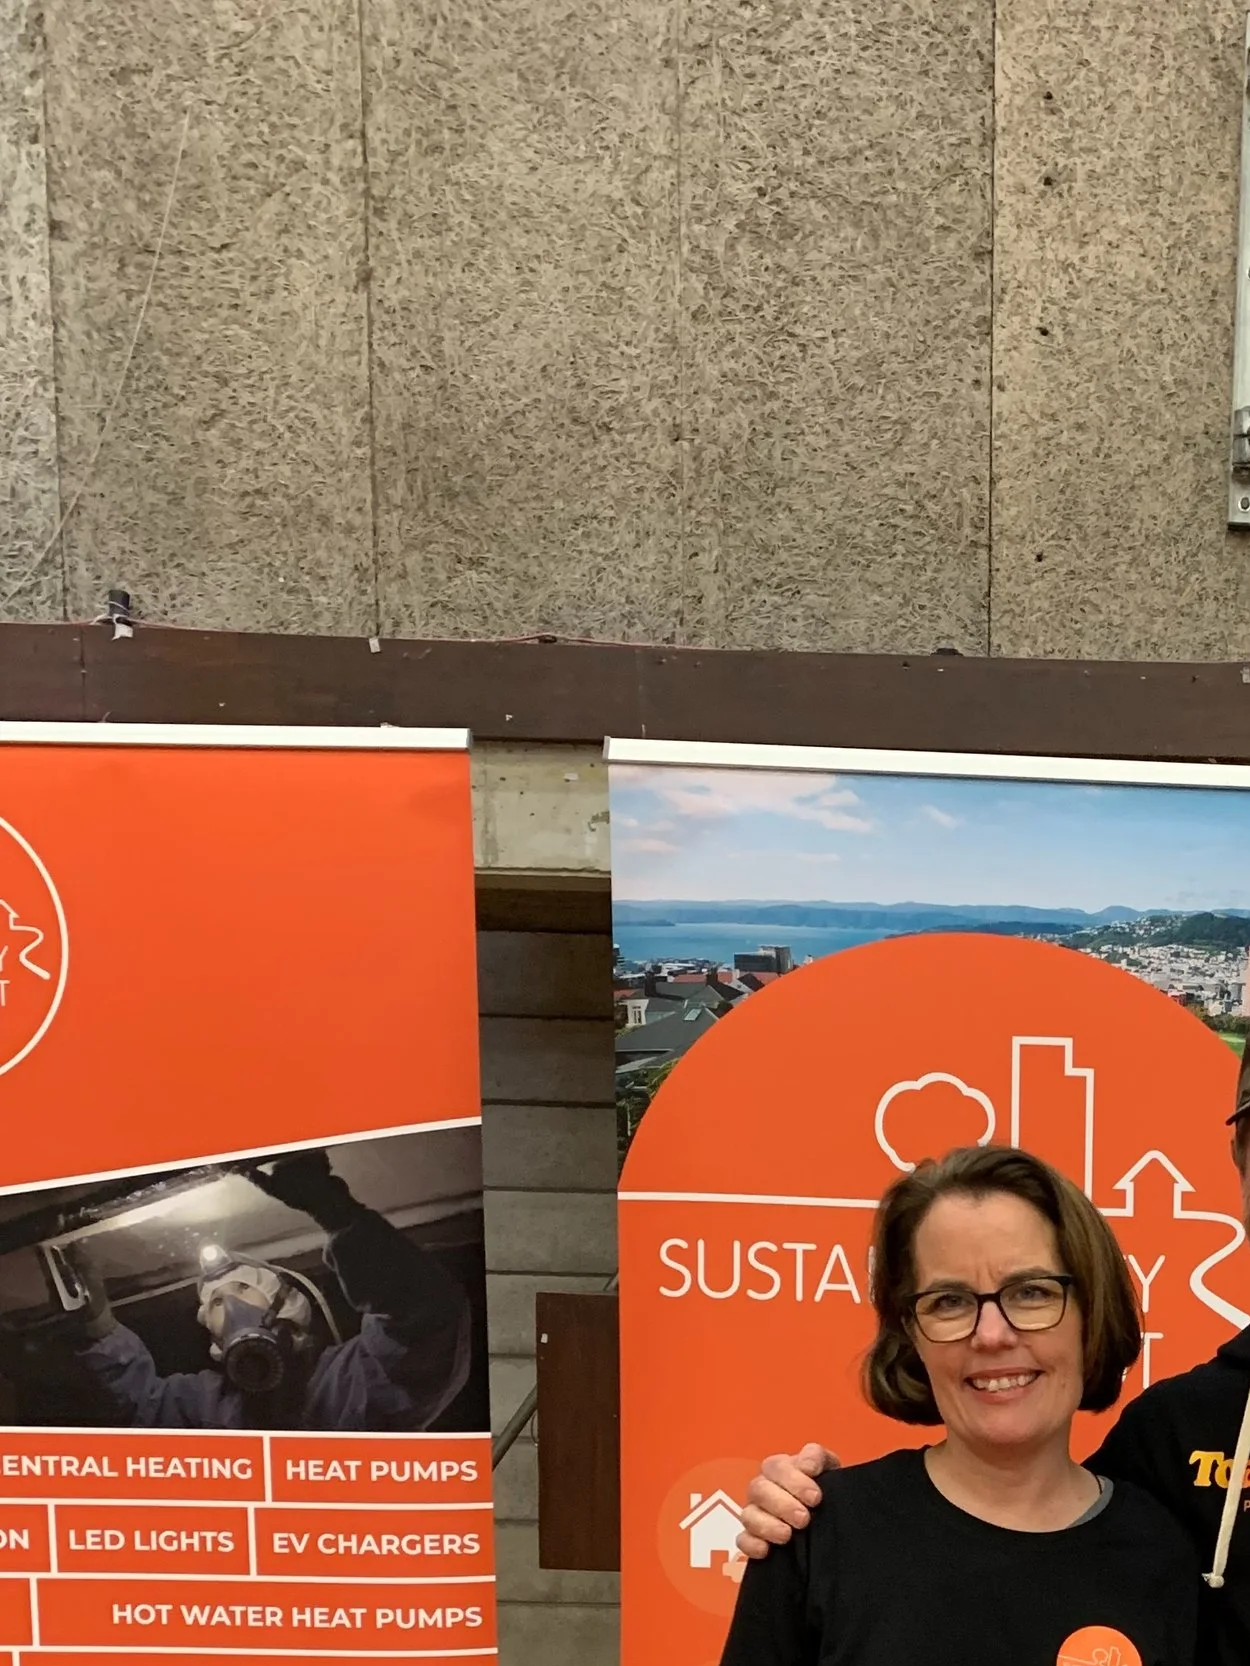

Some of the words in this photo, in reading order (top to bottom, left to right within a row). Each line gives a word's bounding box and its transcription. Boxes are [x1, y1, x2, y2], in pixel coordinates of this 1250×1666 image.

[0, 1455, 119, 1478] ENTRAL
[126, 1456, 253, 1480] HEATING
[286, 1459, 362, 1481] HEAT
[371, 1460, 478, 1482] PUMPS
[69, 1529, 125, 1551] LED
[134, 1530, 235, 1553] LIGHTS
[272, 1532, 311, 1554] EV
[317, 1533, 481, 1556] CHARGERS
[112, 1603, 173, 1625] HOT
[179, 1604, 283, 1628] WATER
[292, 1607, 368, 1629] HEAT
[376, 1606, 483, 1629] PUMPS
